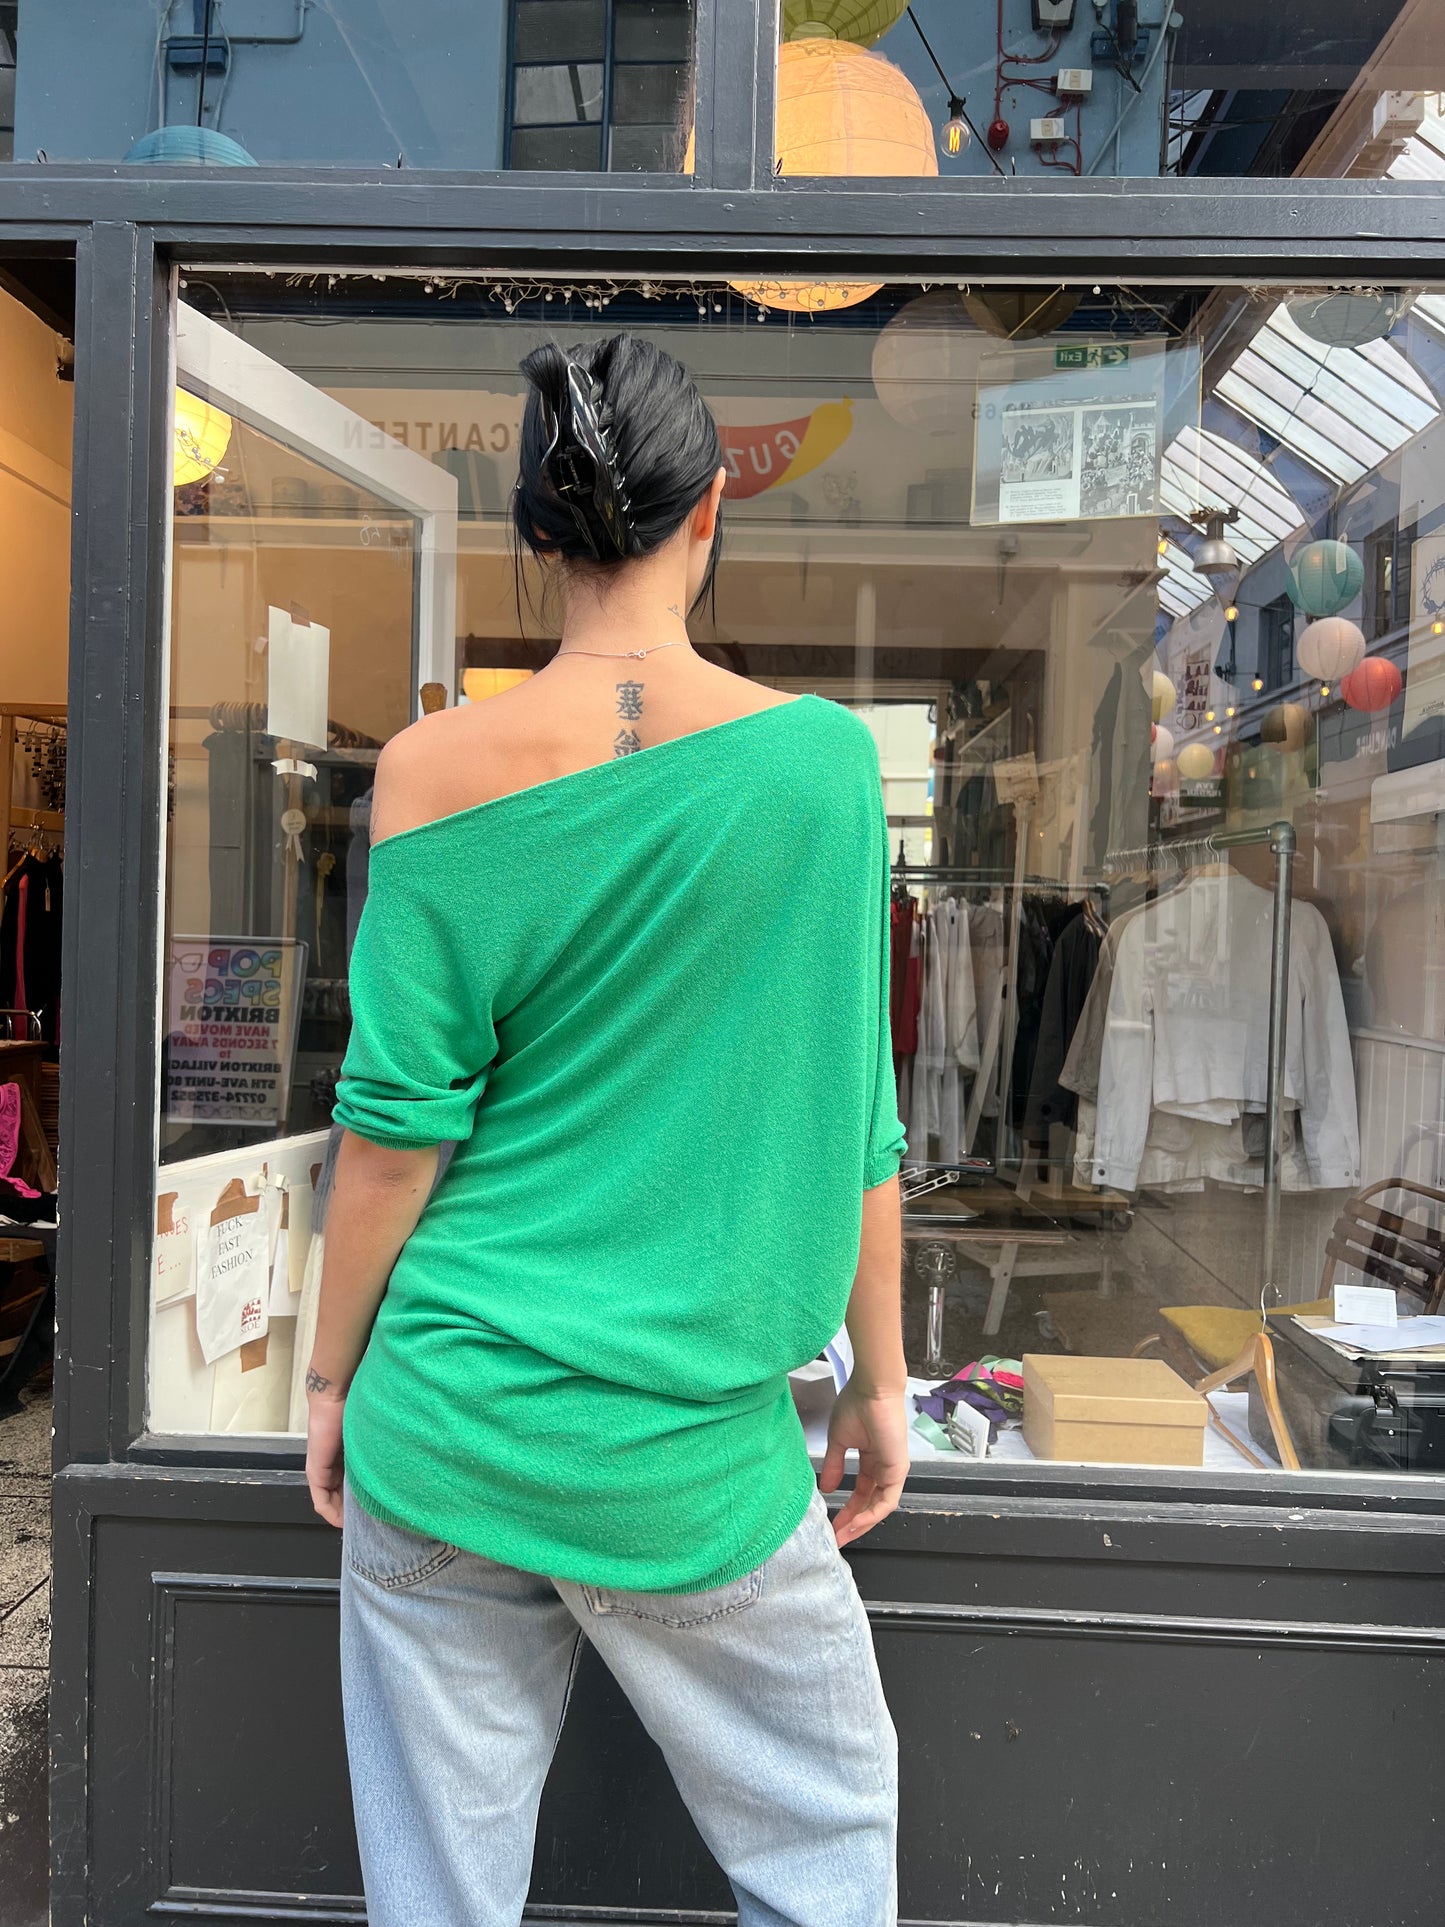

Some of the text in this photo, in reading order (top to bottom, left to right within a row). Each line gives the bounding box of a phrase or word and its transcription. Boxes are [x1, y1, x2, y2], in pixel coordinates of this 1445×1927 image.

[217, 1215, 243, 1237] FUCK
[218, 1234, 242, 1256] FAST
[211, 1249, 253, 1279] FASHION
